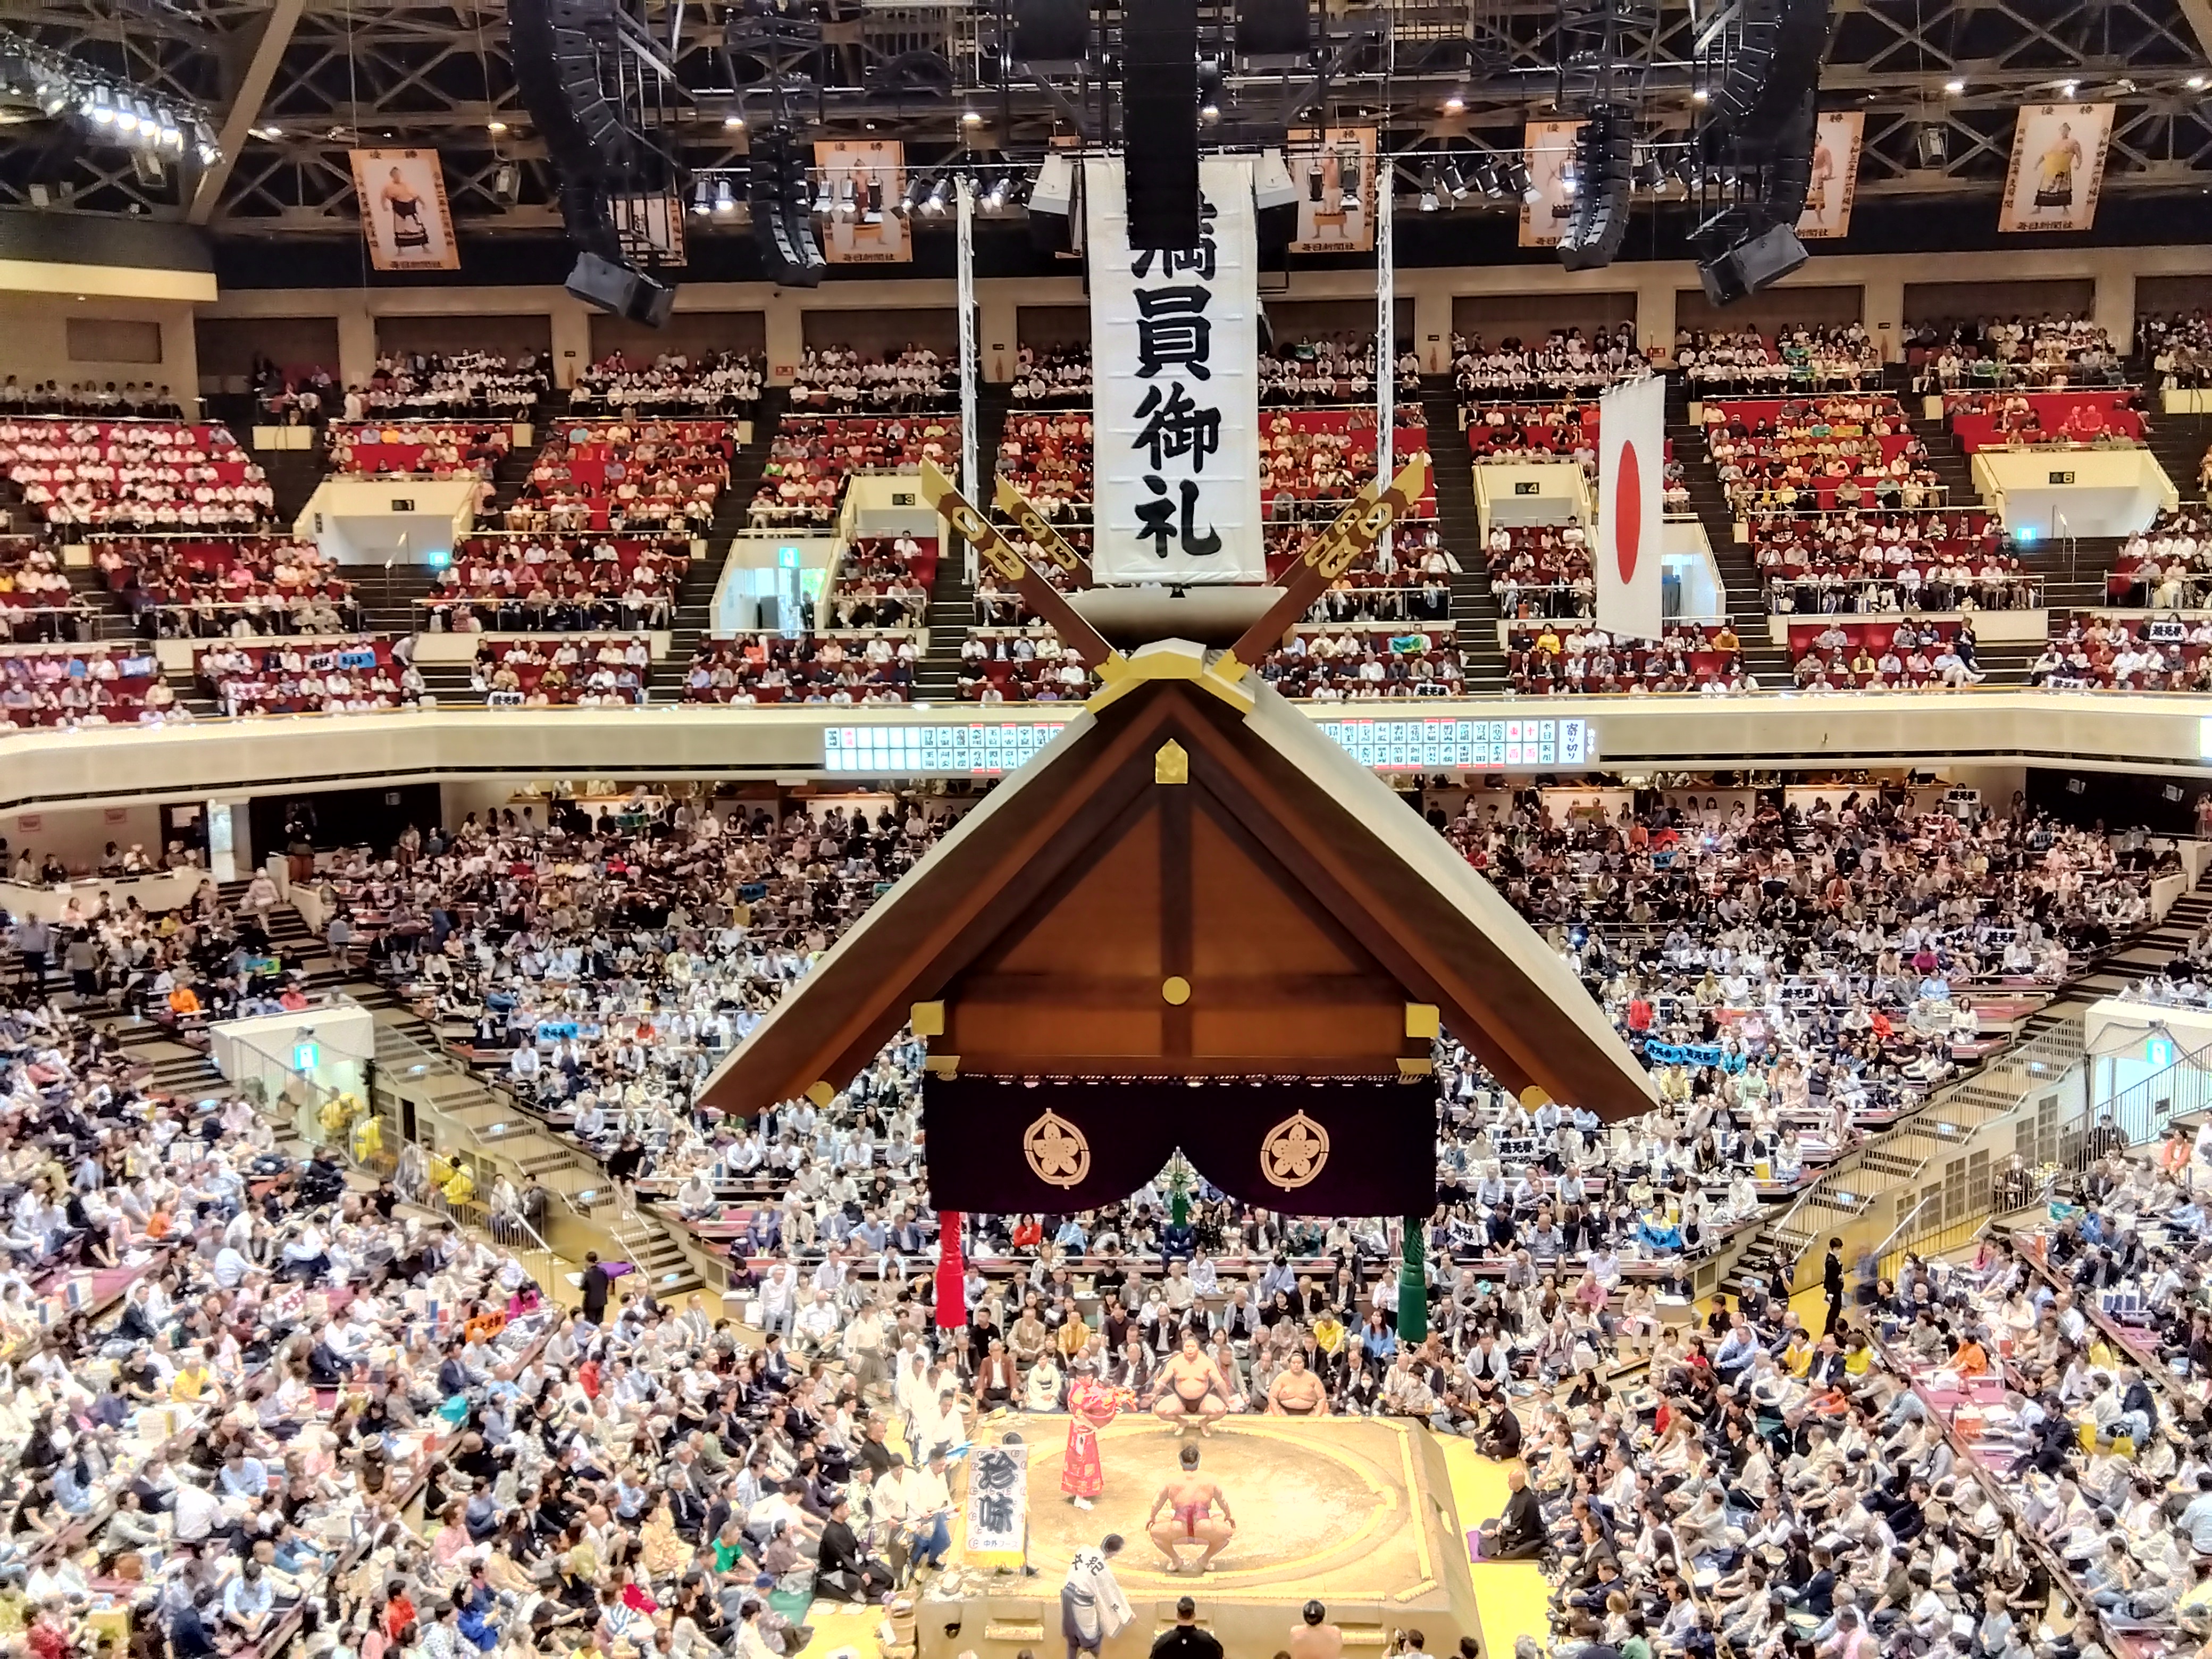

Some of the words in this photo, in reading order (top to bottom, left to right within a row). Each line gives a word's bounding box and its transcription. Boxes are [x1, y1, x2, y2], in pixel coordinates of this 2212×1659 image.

[1528, 483, 1538, 493] 4
[905, 495, 914, 505] 3
[1566, 723, 1578, 760] 寄り切り
[978, 1451, 1018, 1534] 珍味
[983, 1539, 1018, 1548] 中外フーズ
